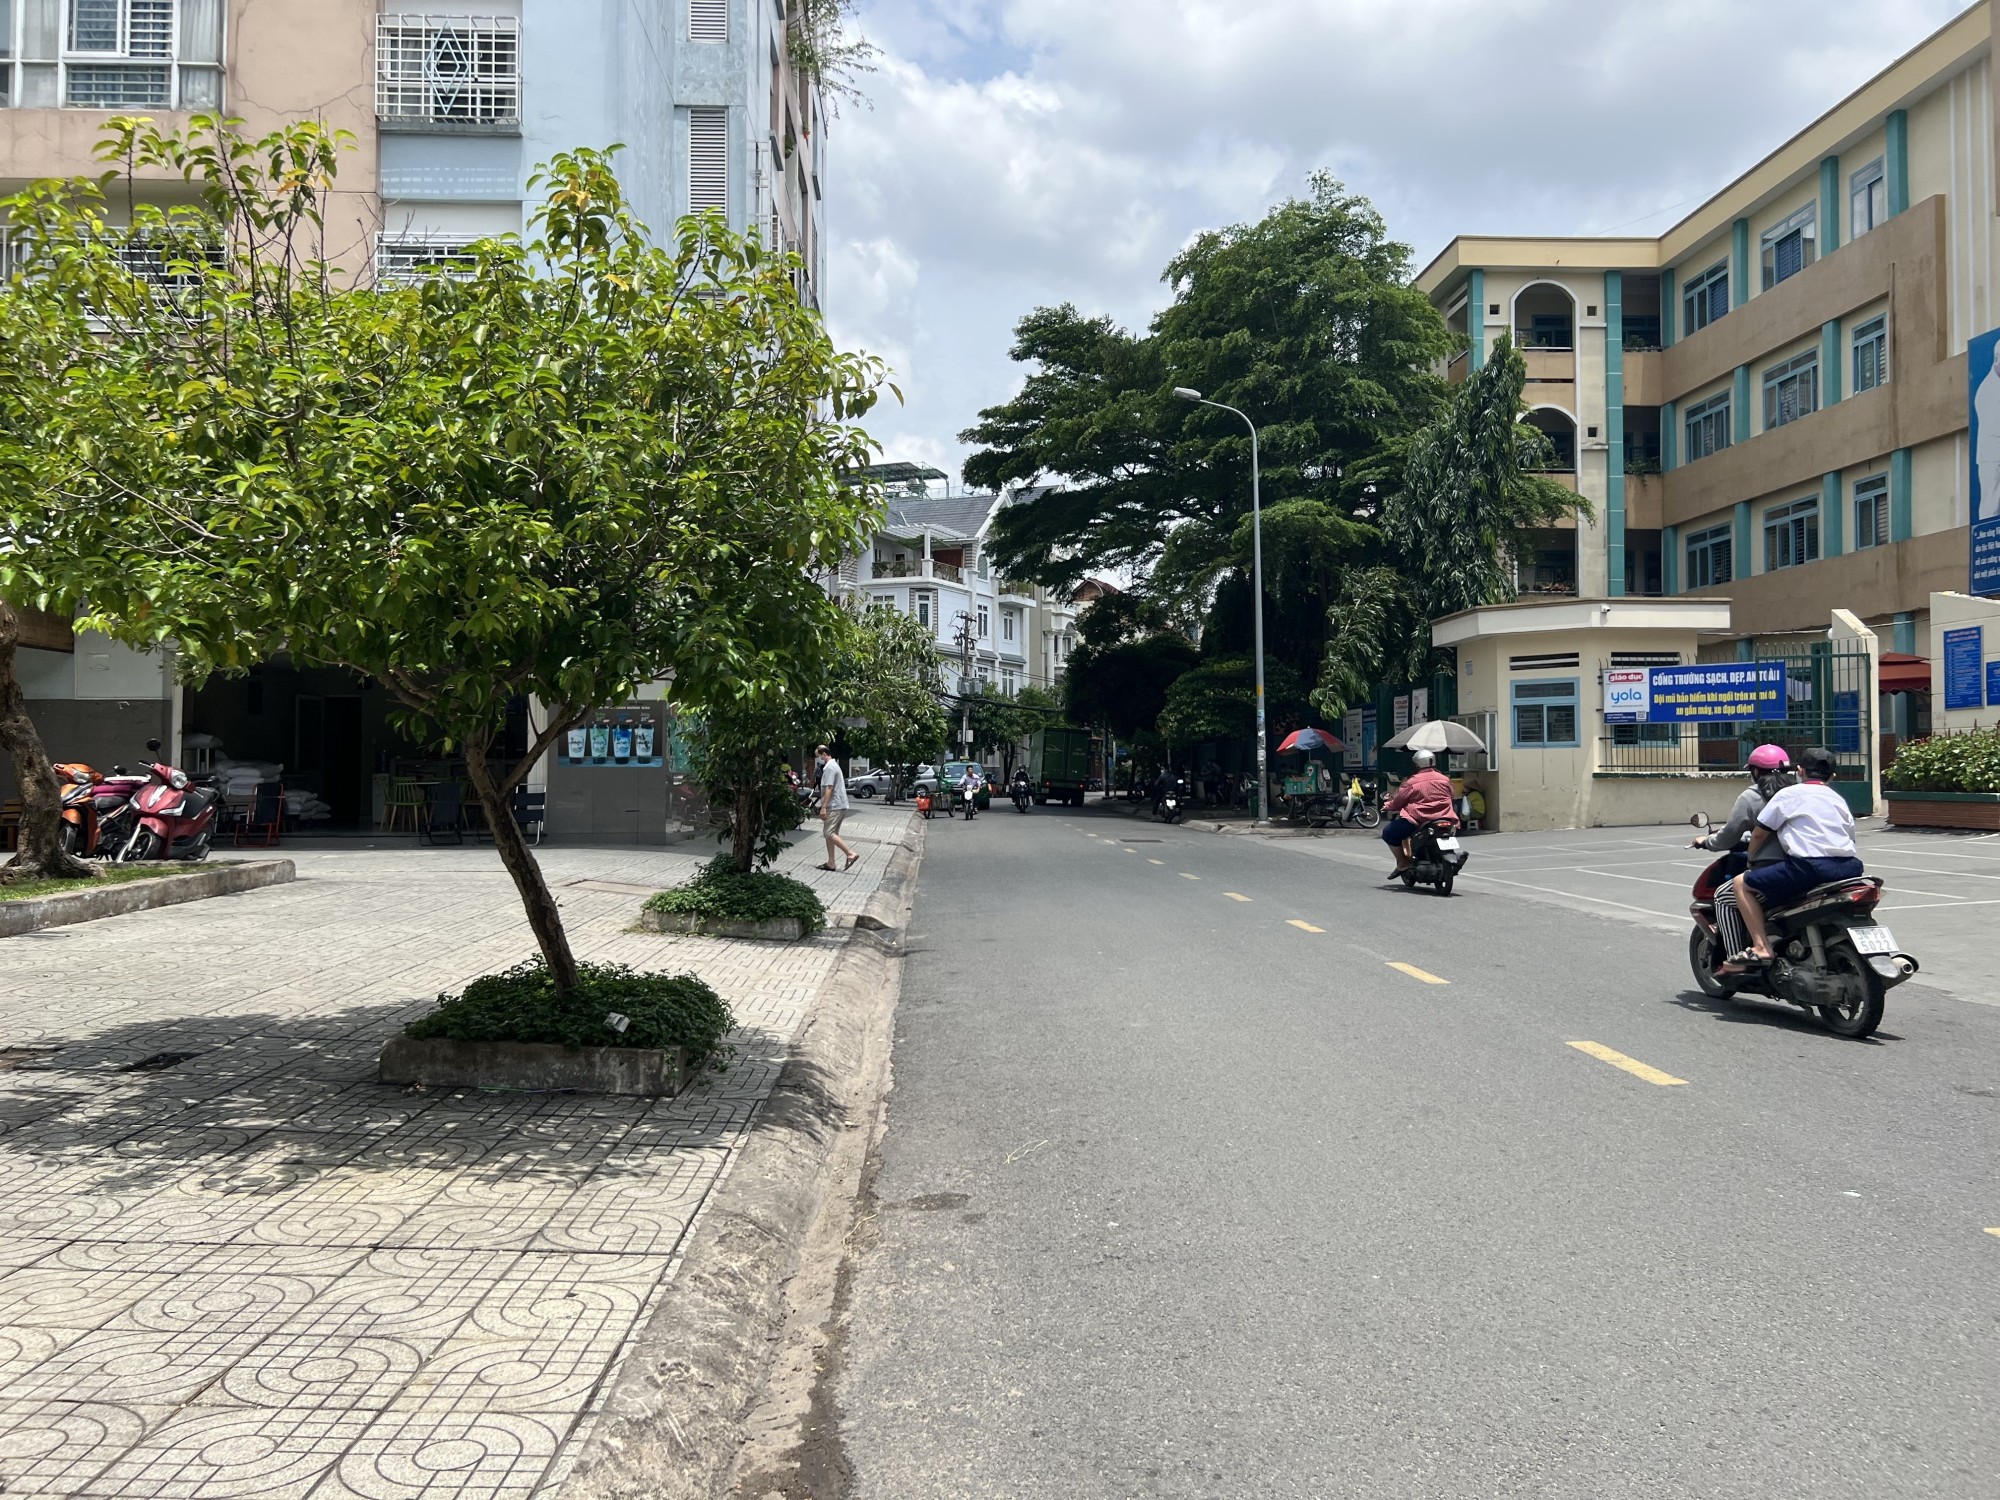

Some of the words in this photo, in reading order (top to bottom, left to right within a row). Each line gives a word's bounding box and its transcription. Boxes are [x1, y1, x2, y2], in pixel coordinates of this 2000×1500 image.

[1674, 671, 1705, 685] TRƯỜNG
[1705, 672, 1729, 686] SẠCH,
[1746, 670, 1757, 682] AN
[1610, 688, 1643, 704] yola
[1860, 939, 1893, 952] 5022
